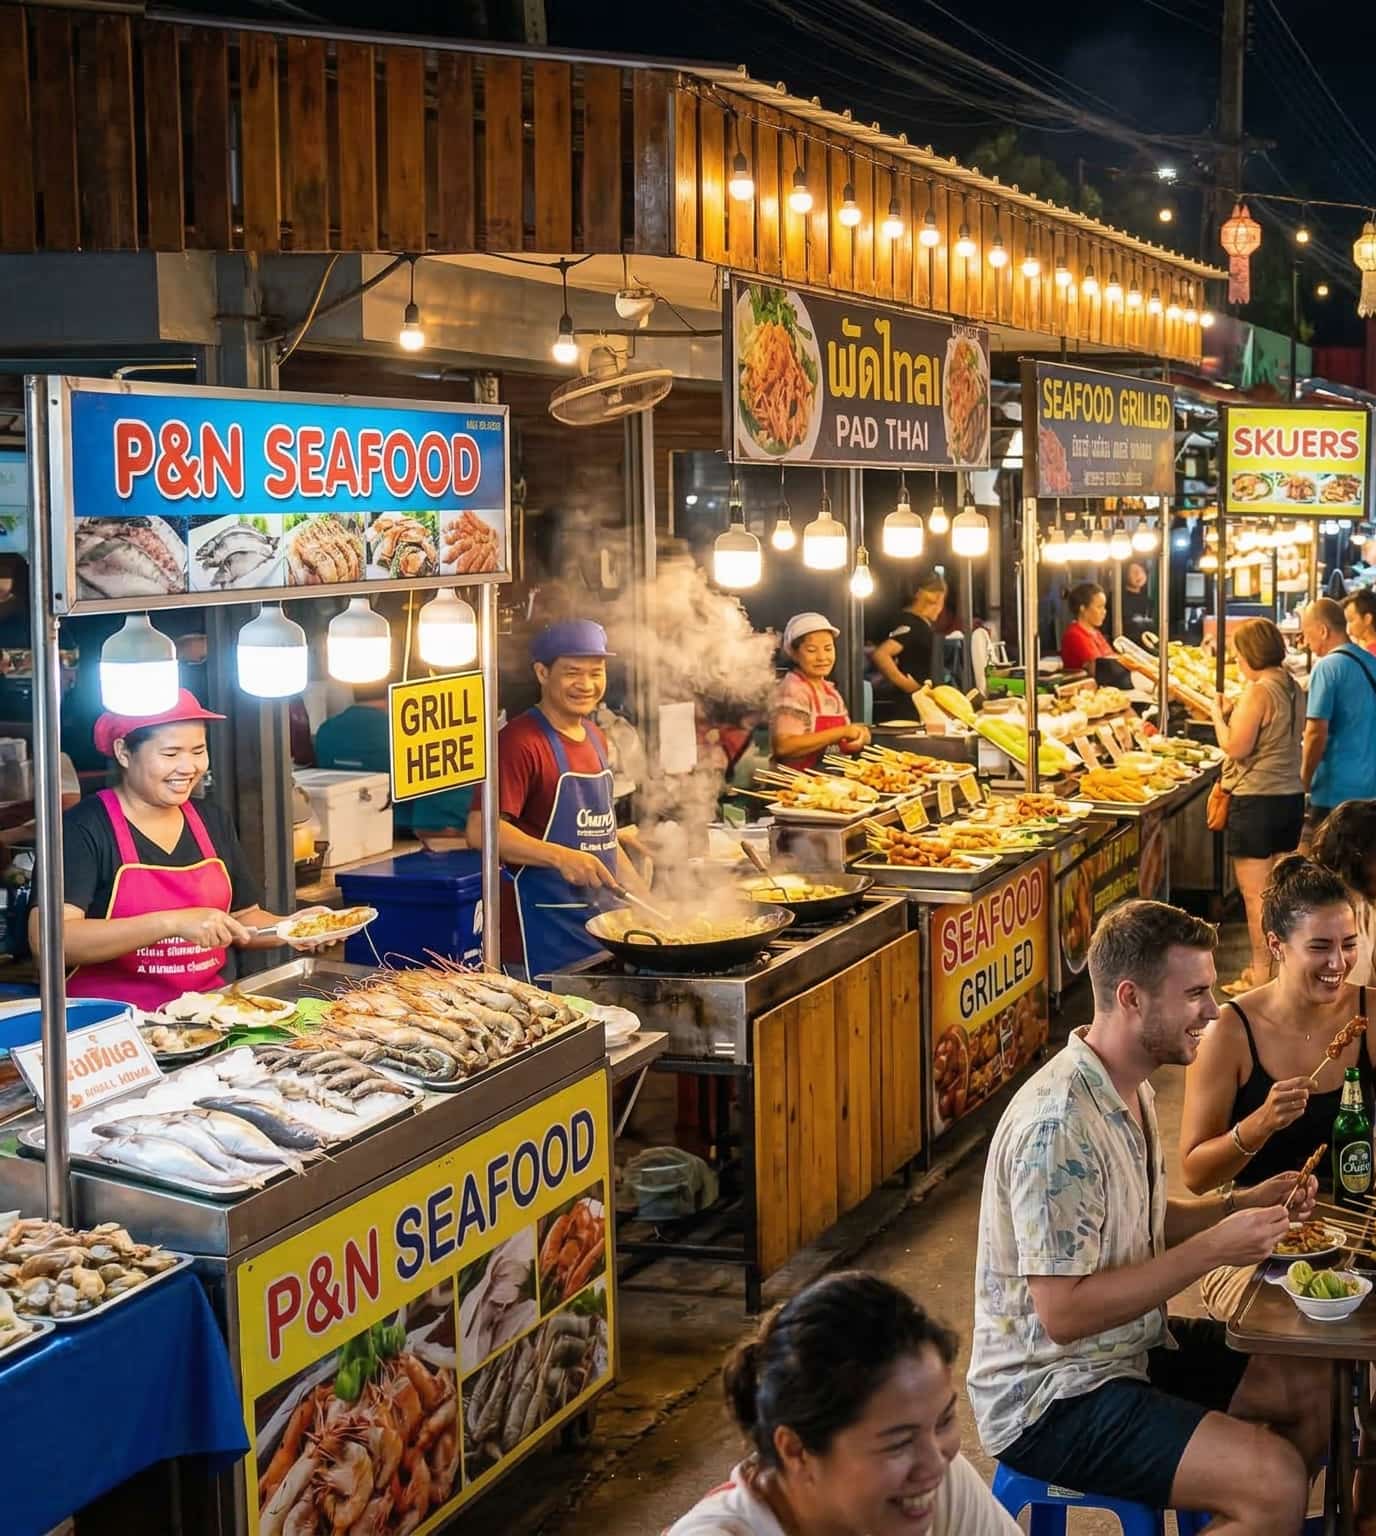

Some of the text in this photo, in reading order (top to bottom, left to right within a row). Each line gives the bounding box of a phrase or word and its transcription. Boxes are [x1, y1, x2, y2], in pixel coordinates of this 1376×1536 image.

[1043, 377, 1171, 430] SEAFOOD GRILLED
[836, 414, 928, 451] PAD THAI
[1233, 426, 1360, 460] SKUERS
[113, 419, 482, 500] P&N SEAFOOD
[400, 688, 477, 737] GRILL
[406, 734, 474, 785] HERE
[941, 867, 1045, 976] SEAFOOD
[959, 938, 1034, 1021] GRILLED
[265, 1108, 596, 1360] P&N SEAFOOD
